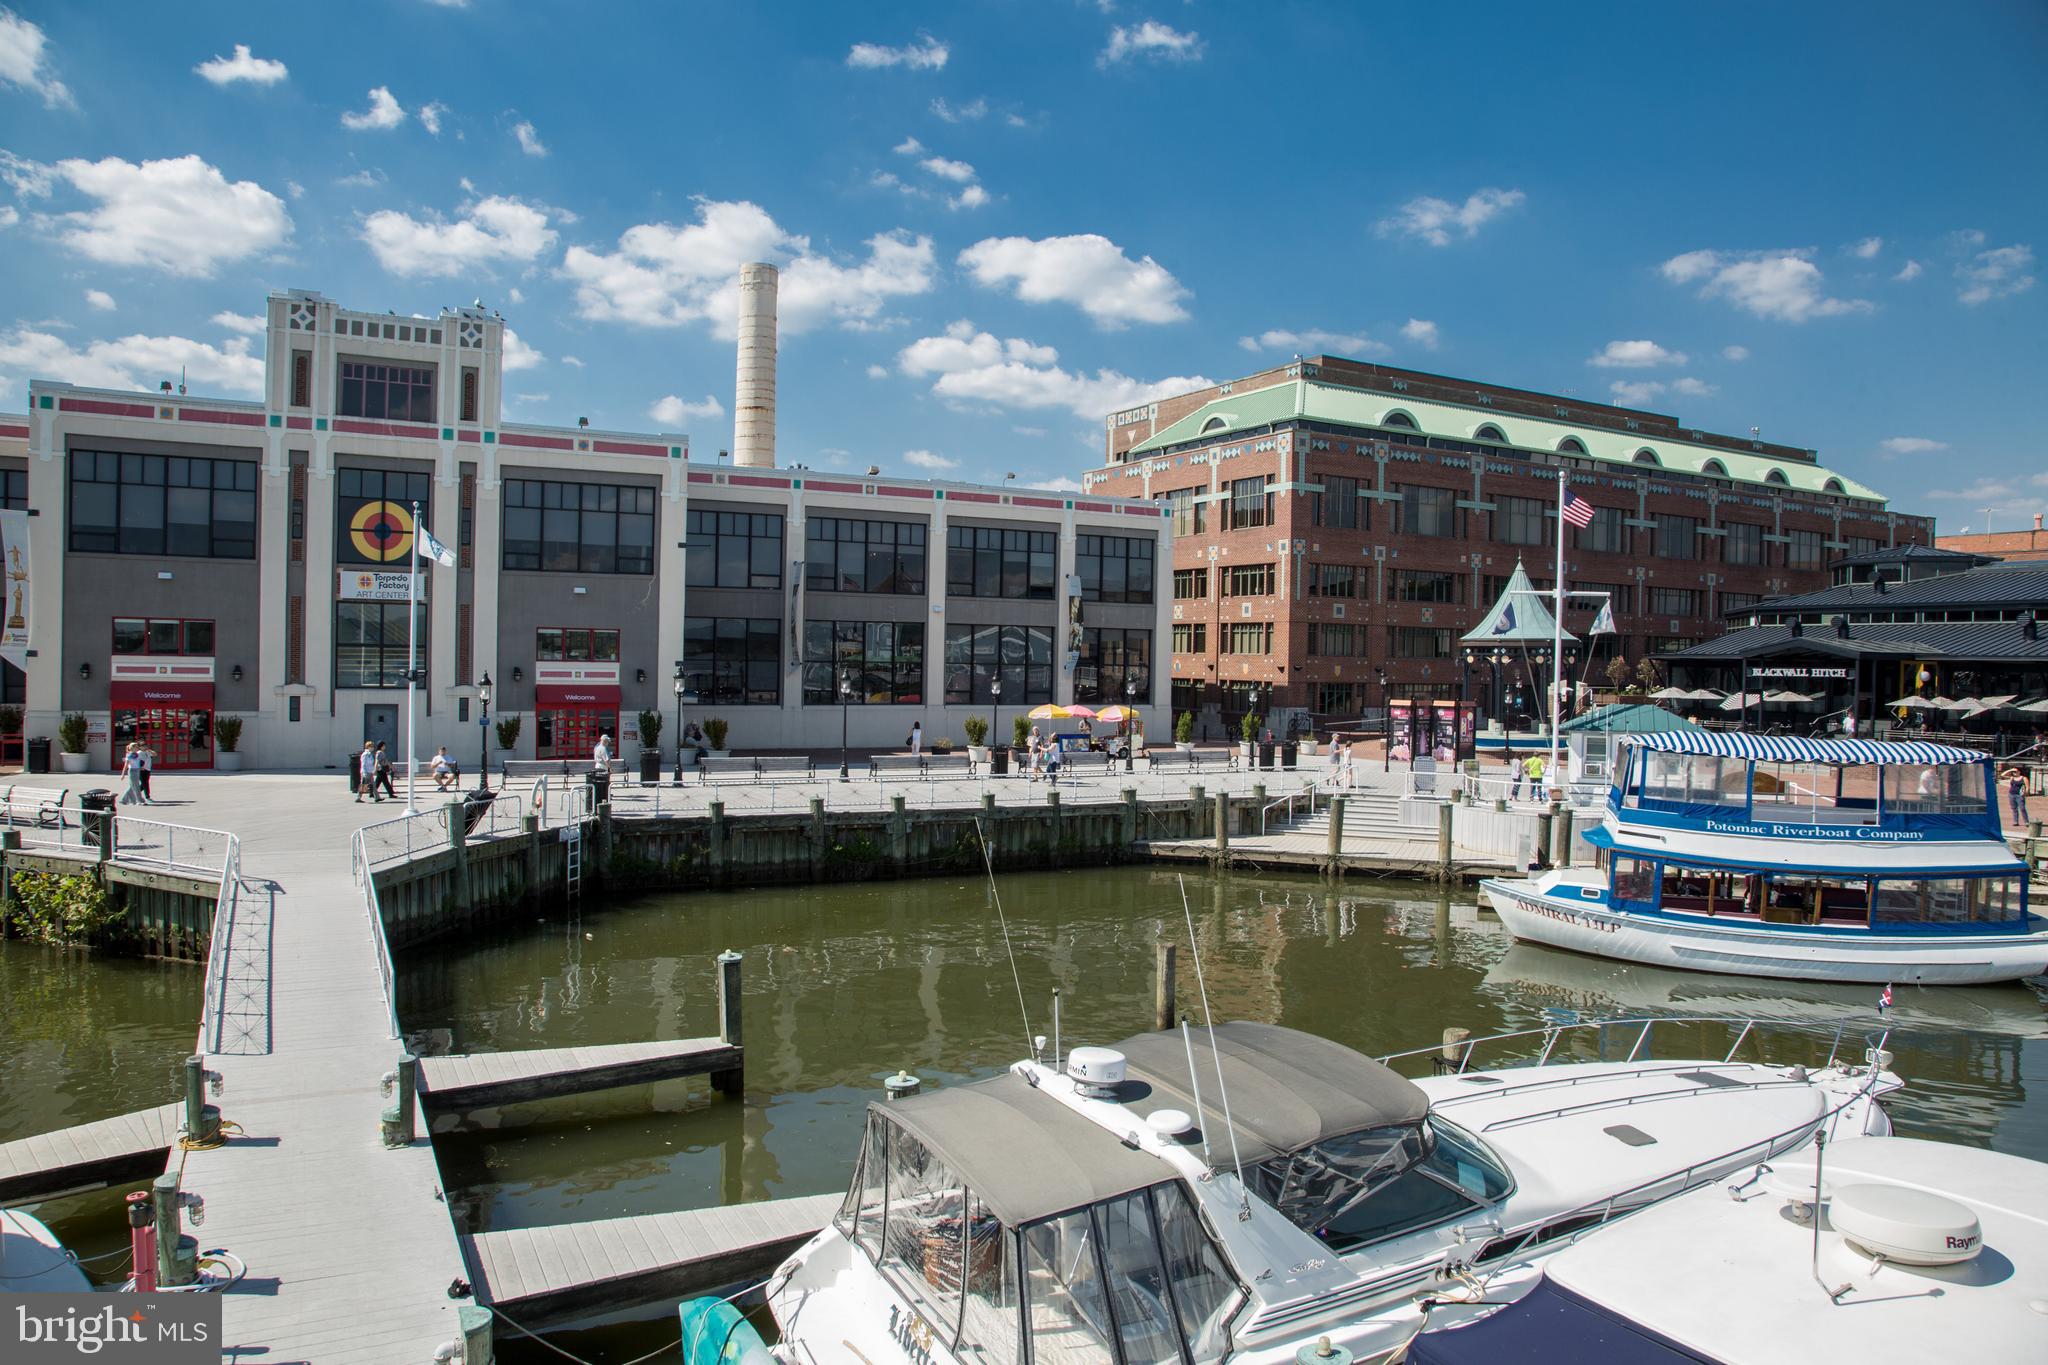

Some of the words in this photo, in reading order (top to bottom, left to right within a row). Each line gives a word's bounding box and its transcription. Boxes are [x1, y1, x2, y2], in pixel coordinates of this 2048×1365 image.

[373, 573, 408, 582] Torpedo
[379, 581, 409, 591] Factory
[375, 591, 409, 599] CENTER
[1752, 668, 1809, 677] BLACKWALL
[1811, 668, 1847, 678] HITCH
[1706, 820, 1767, 834] Potomac
[1773, 825, 1850, 838] Riverboat
[1856, 828, 1925, 841] Company
[1516, 899, 1580, 926] ADMIRAL
